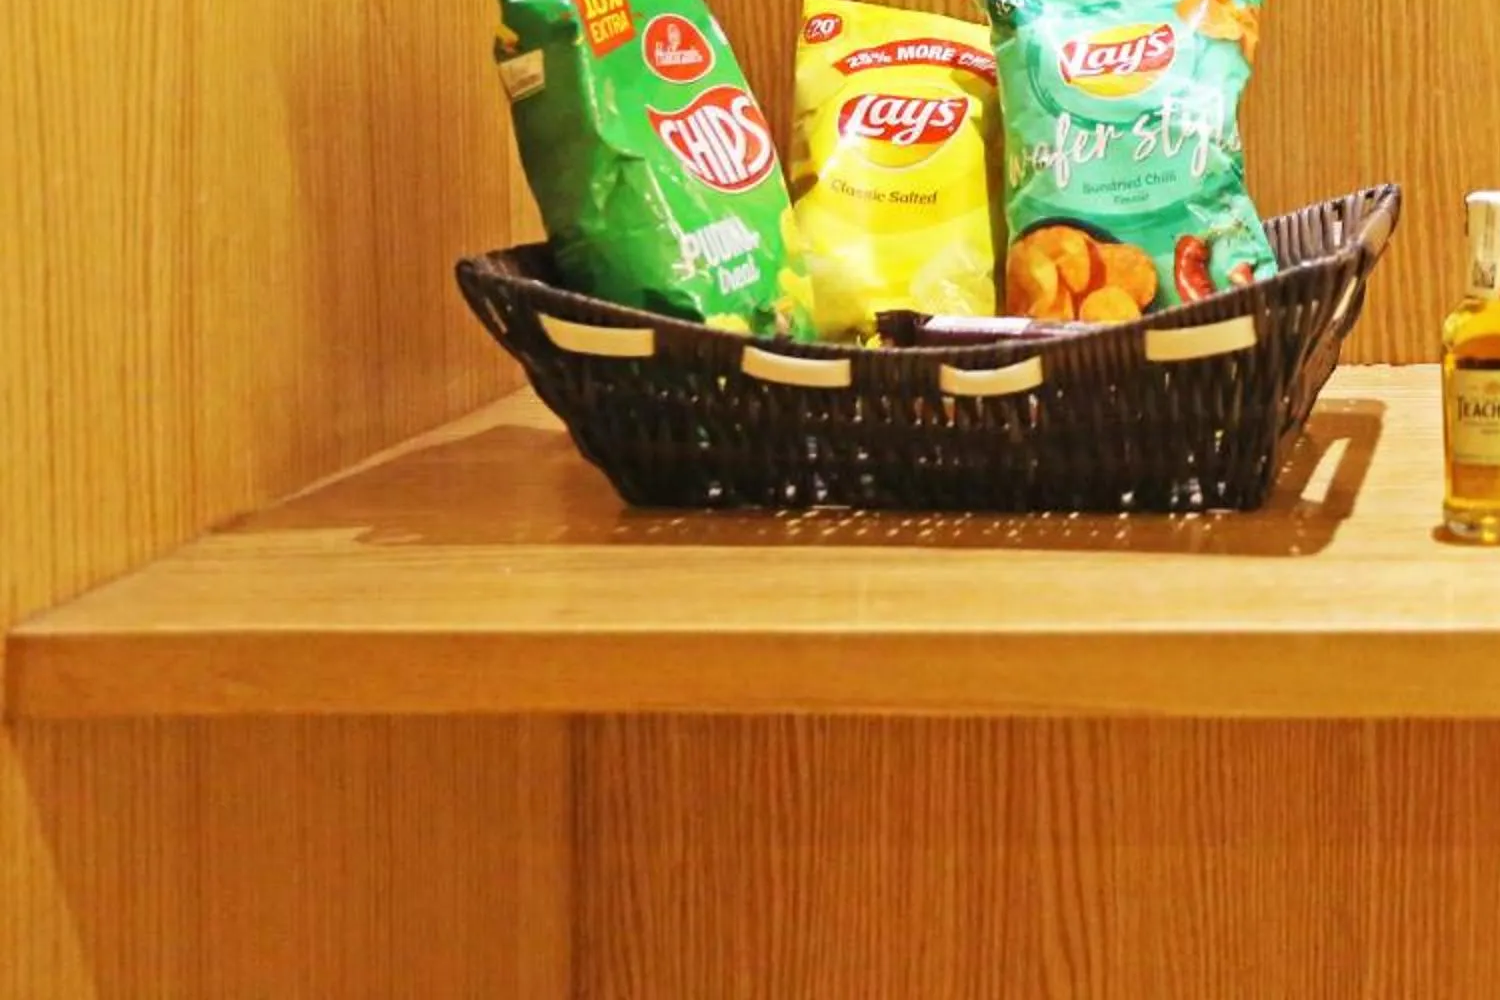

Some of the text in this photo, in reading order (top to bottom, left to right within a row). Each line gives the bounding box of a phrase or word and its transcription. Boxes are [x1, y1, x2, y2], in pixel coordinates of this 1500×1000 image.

[590, 9, 629, 44] EXTRA
[896, 44, 954, 61] MORE
[660, 96, 770, 184] CHIPS
[888, 189, 937, 204] Salted
